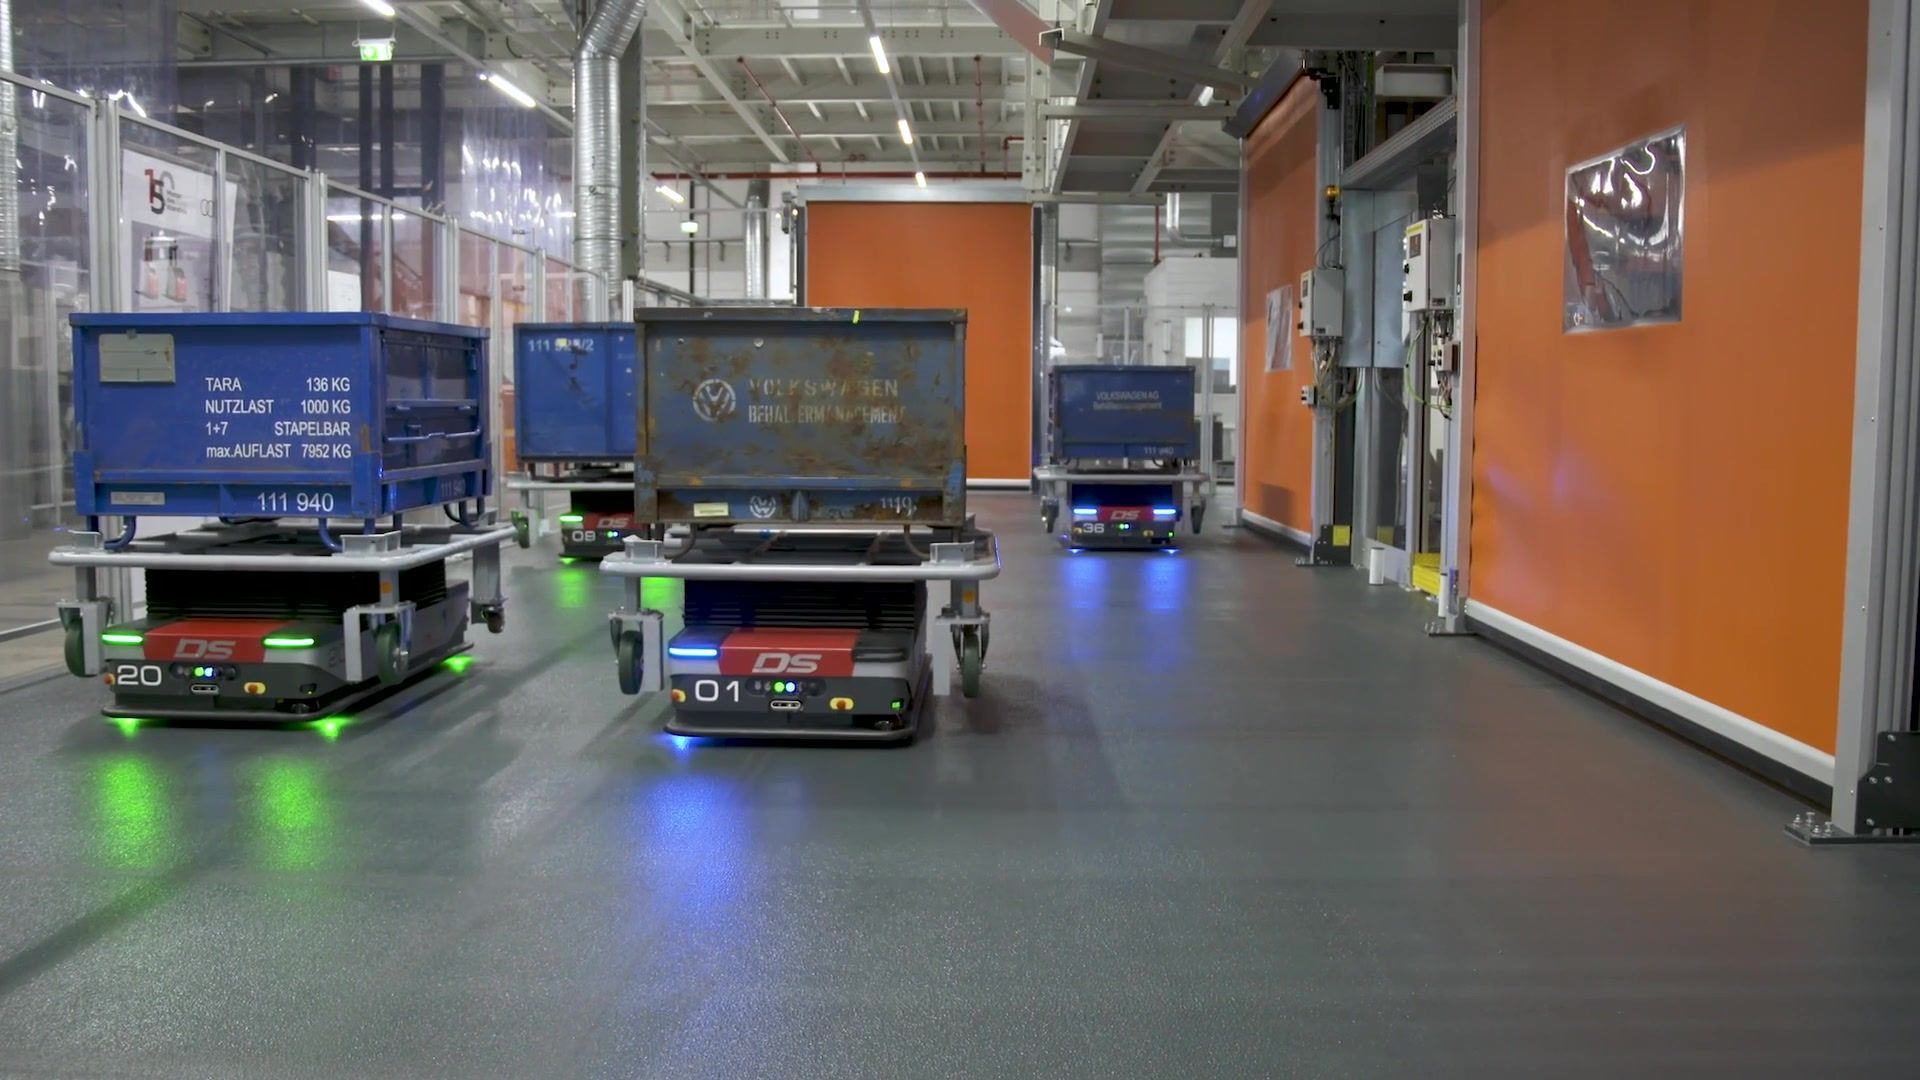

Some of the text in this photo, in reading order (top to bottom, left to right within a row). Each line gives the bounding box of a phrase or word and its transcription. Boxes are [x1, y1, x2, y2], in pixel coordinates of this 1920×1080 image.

[528, 340, 550, 352] 111
[205, 377, 350, 392] TARA 136 KG
[1096, 390, 1159, 400] VOLKSWAGEN AG
[205, 399, 350, 414] NUTZLAST 1000 KG
[205, 421, 350, 436] 1+7 STAPELBAR
[206, 443, 351, 458] max.AUFLAST 7952 KG
[1143, 446, 1156, 455] 111
[257, 492, 334, 512] 111 940
[597, 517, 630, 529] DS
[1110, 510, 1140, 521] DS
[1083, 523, 1105, 533] 36
[174, 638, 236, 659] DS
[752, 652, 822, 674] DS
[117, 665, 162, 686] 20
[695, 680, 740, 702] 01
